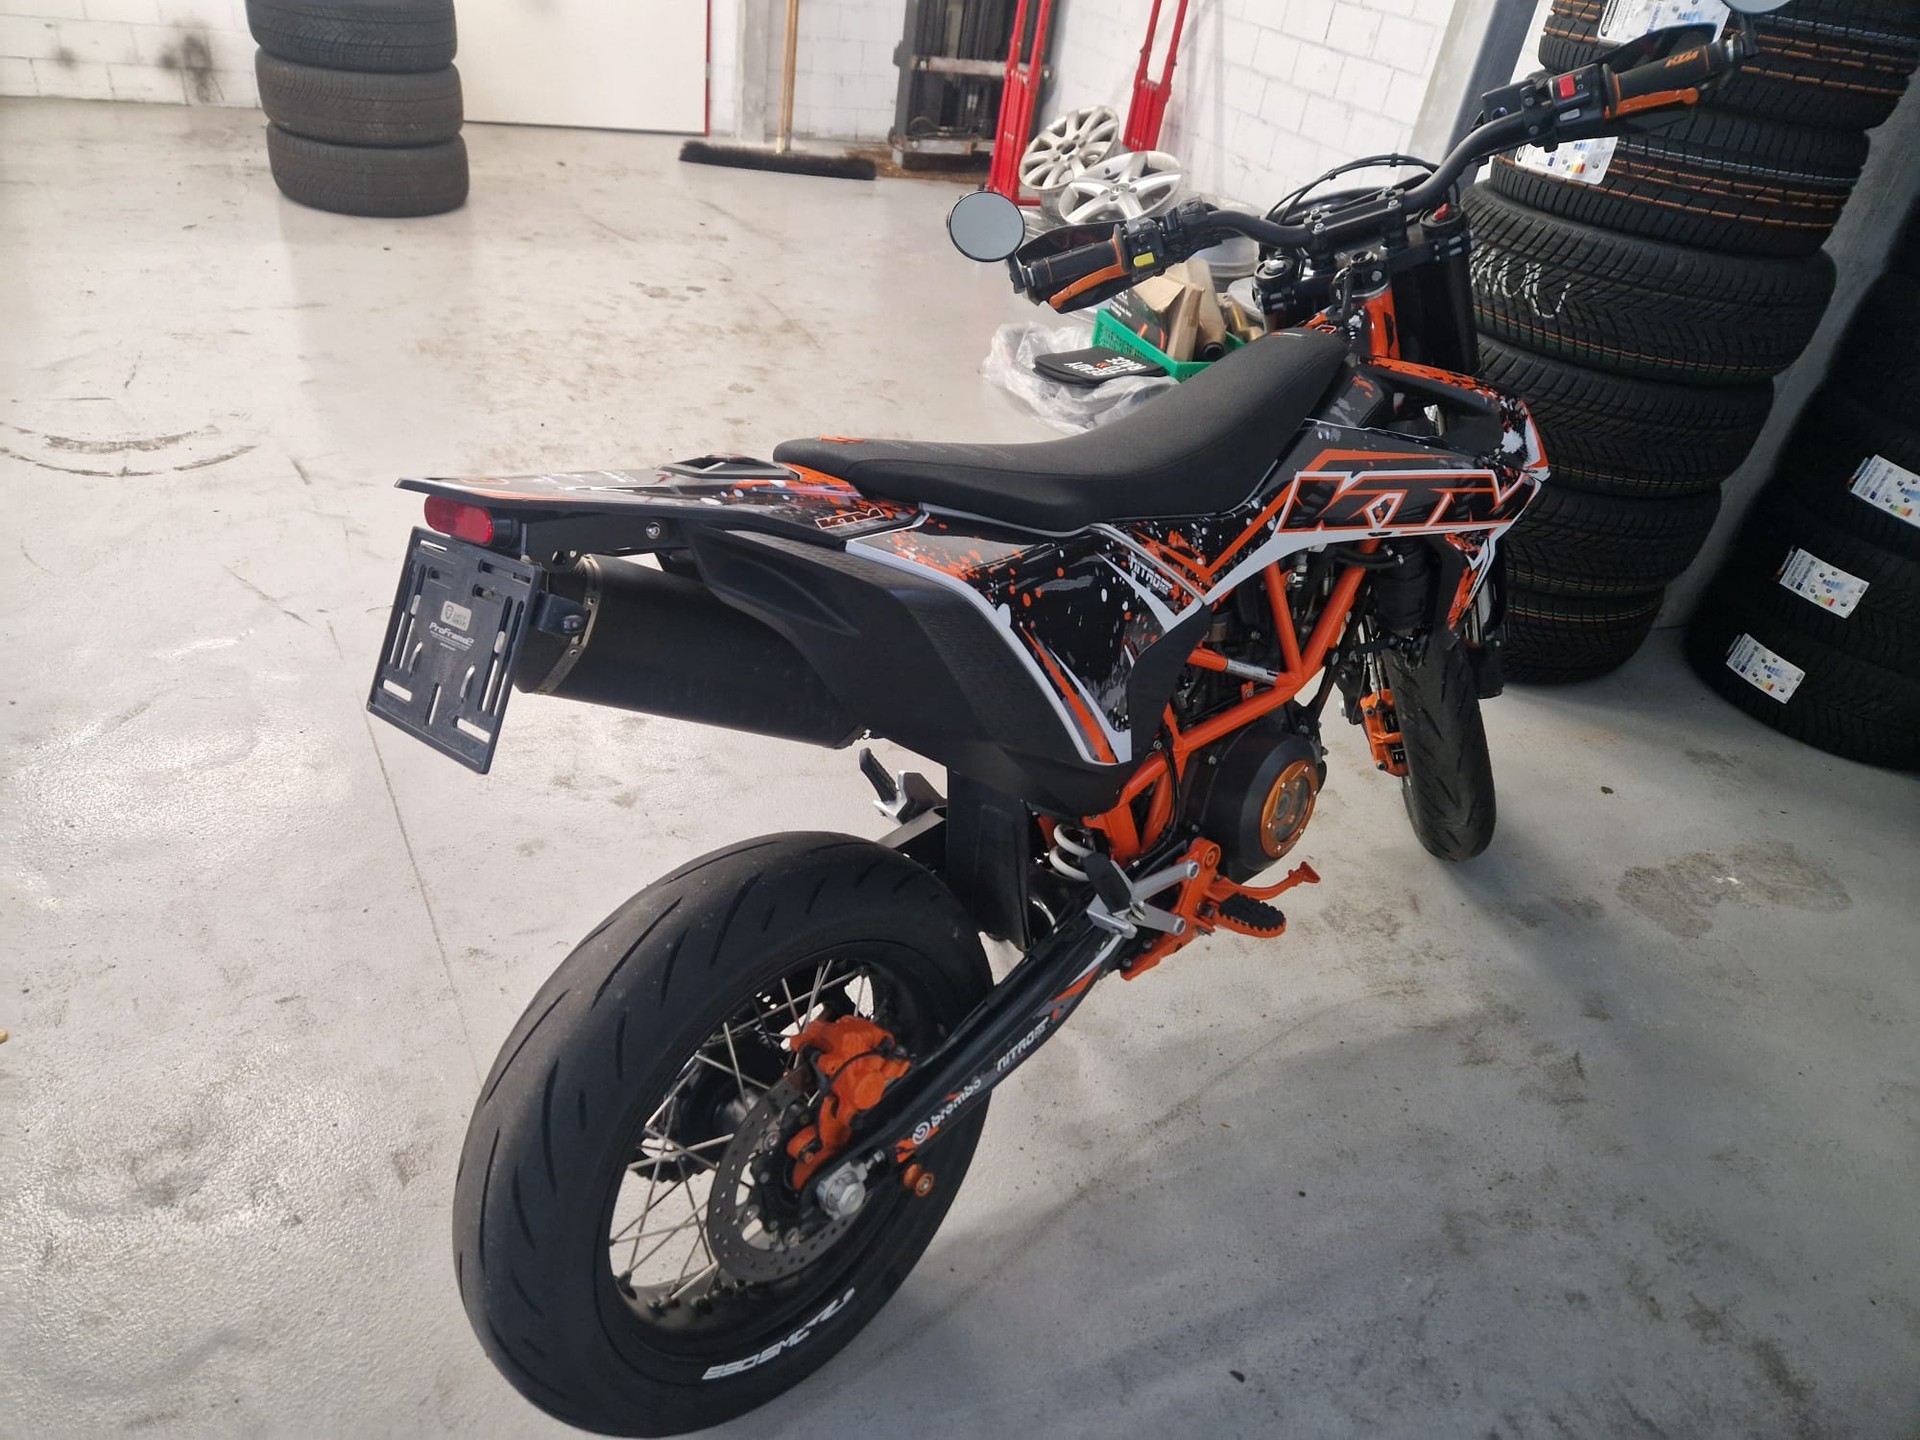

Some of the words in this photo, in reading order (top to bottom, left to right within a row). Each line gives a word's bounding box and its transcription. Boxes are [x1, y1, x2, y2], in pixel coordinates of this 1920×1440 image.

[815, 507, 884, 530] KTM
[1275, 469, 1541, 534] KTM
[931, 1078, 982, 1127] brembo
